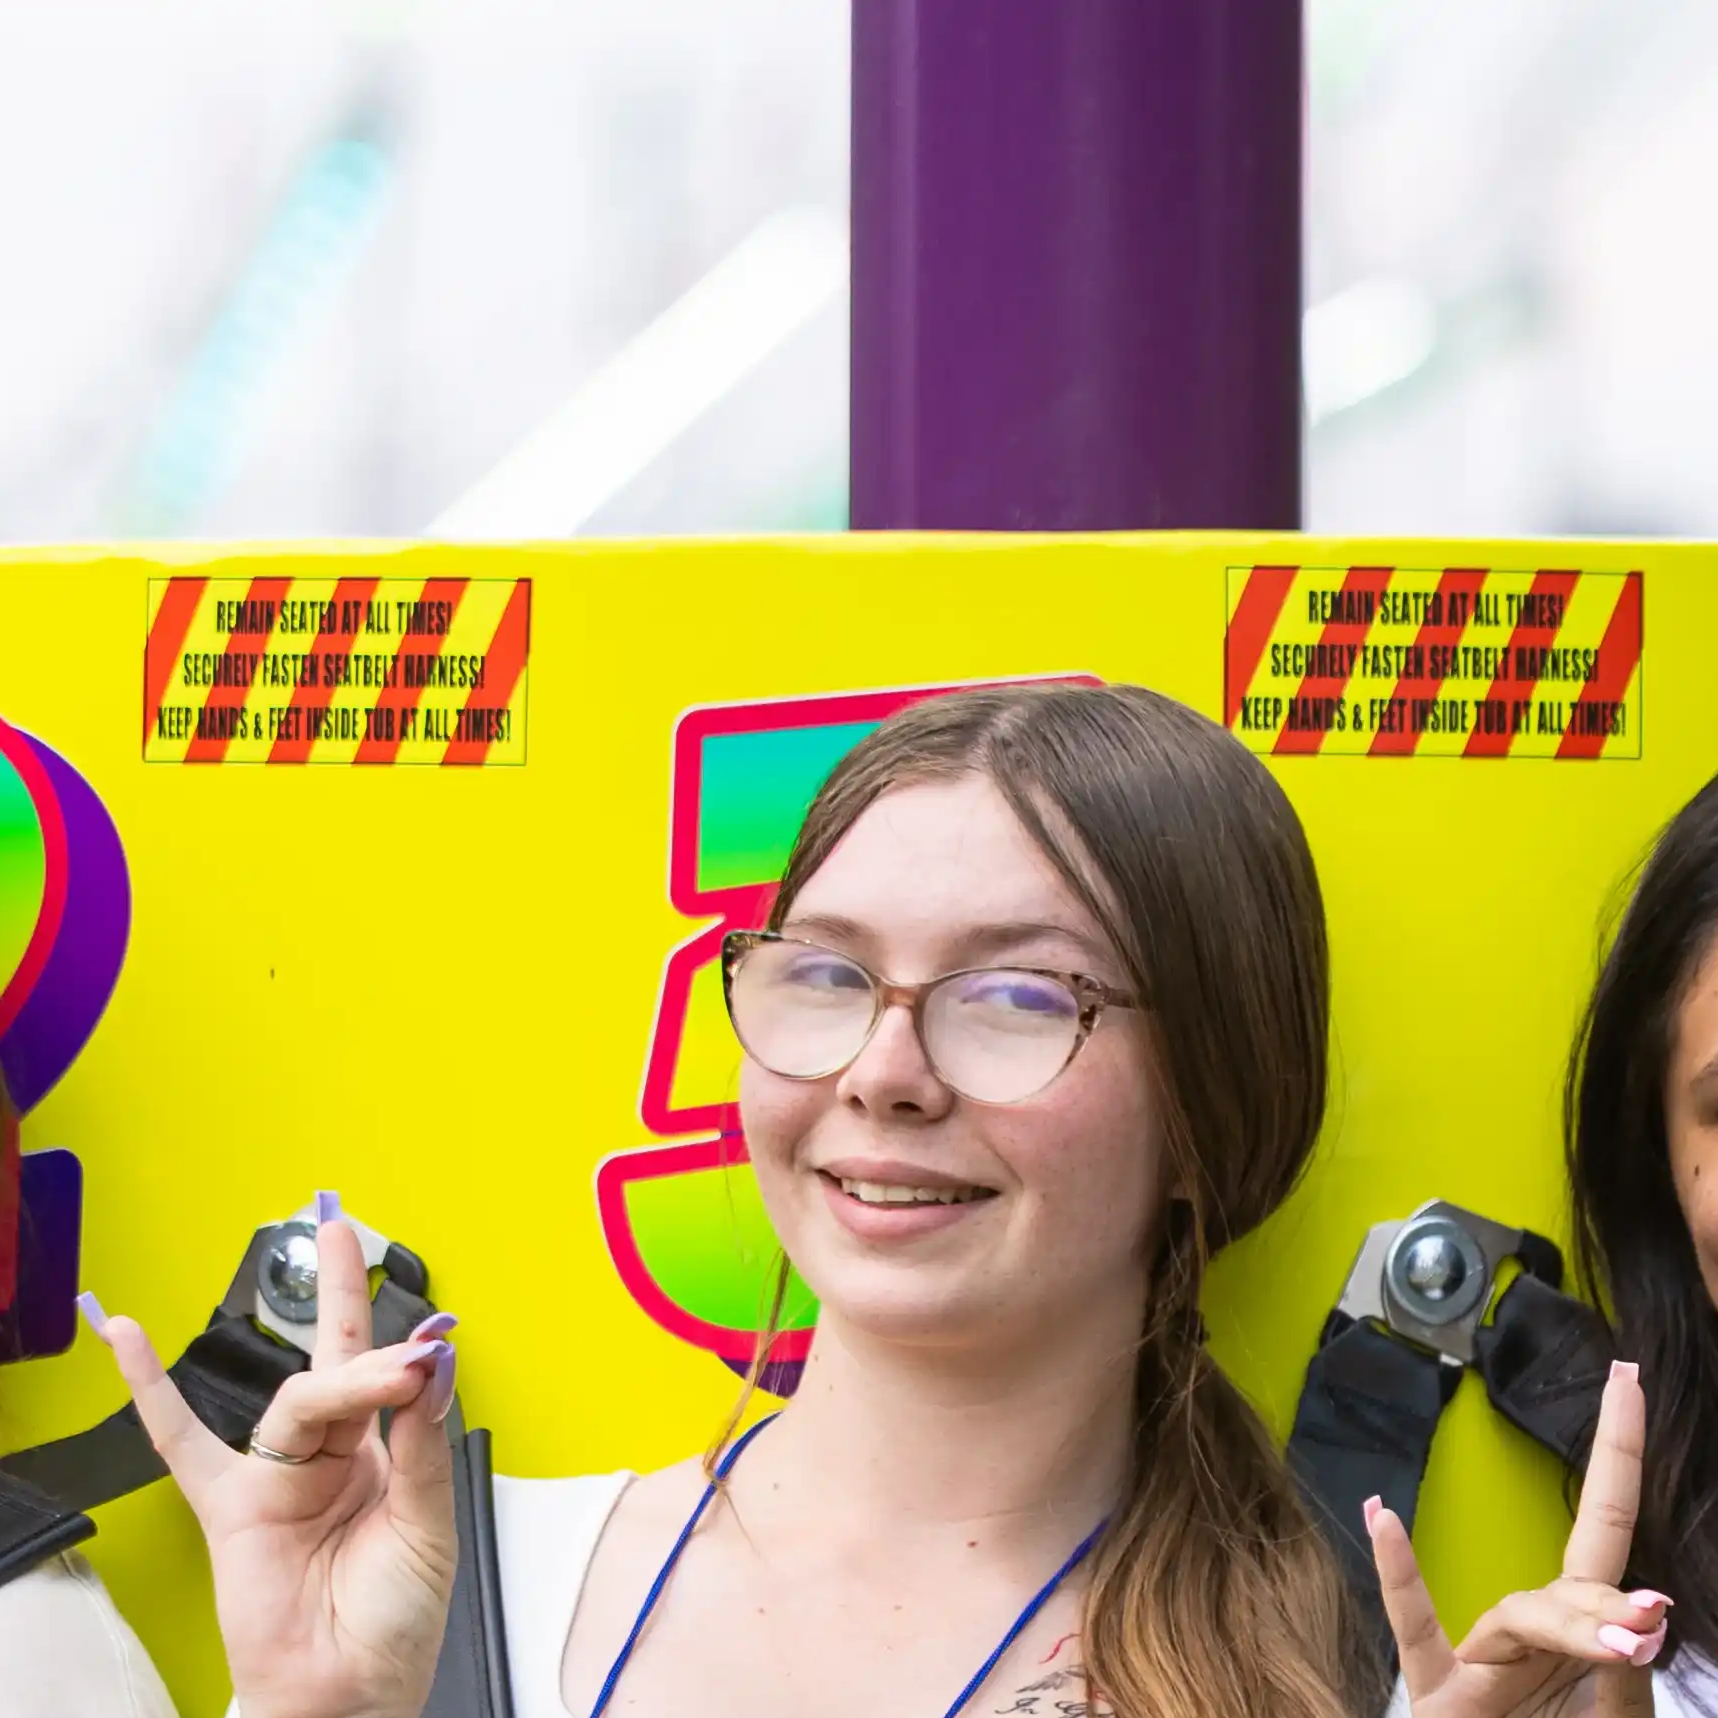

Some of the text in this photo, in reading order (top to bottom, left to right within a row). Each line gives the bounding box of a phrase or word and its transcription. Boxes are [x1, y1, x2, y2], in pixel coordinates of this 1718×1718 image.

[217, 600, 452, 636] REMAIN SEATED AT ALL TIMES!
[1308, 590, 1564, 628] REMAIN SEATED AT ALL TIMES!
[183, 654, 486, 688] SECURELY FASTEN SEATBELT HARNESS!
[1271, 644, 1599, 682] SECURELY FASTEN SEATBELT HARNESS!
[157, 706, 511, 742] KEEP HANDS & FEET INSIDE TUB AT ALL TIMES!
[1241, 696, 1626, 736] KEEP HANDS & FEET INSIDE TUB AT ALL TIMES!
